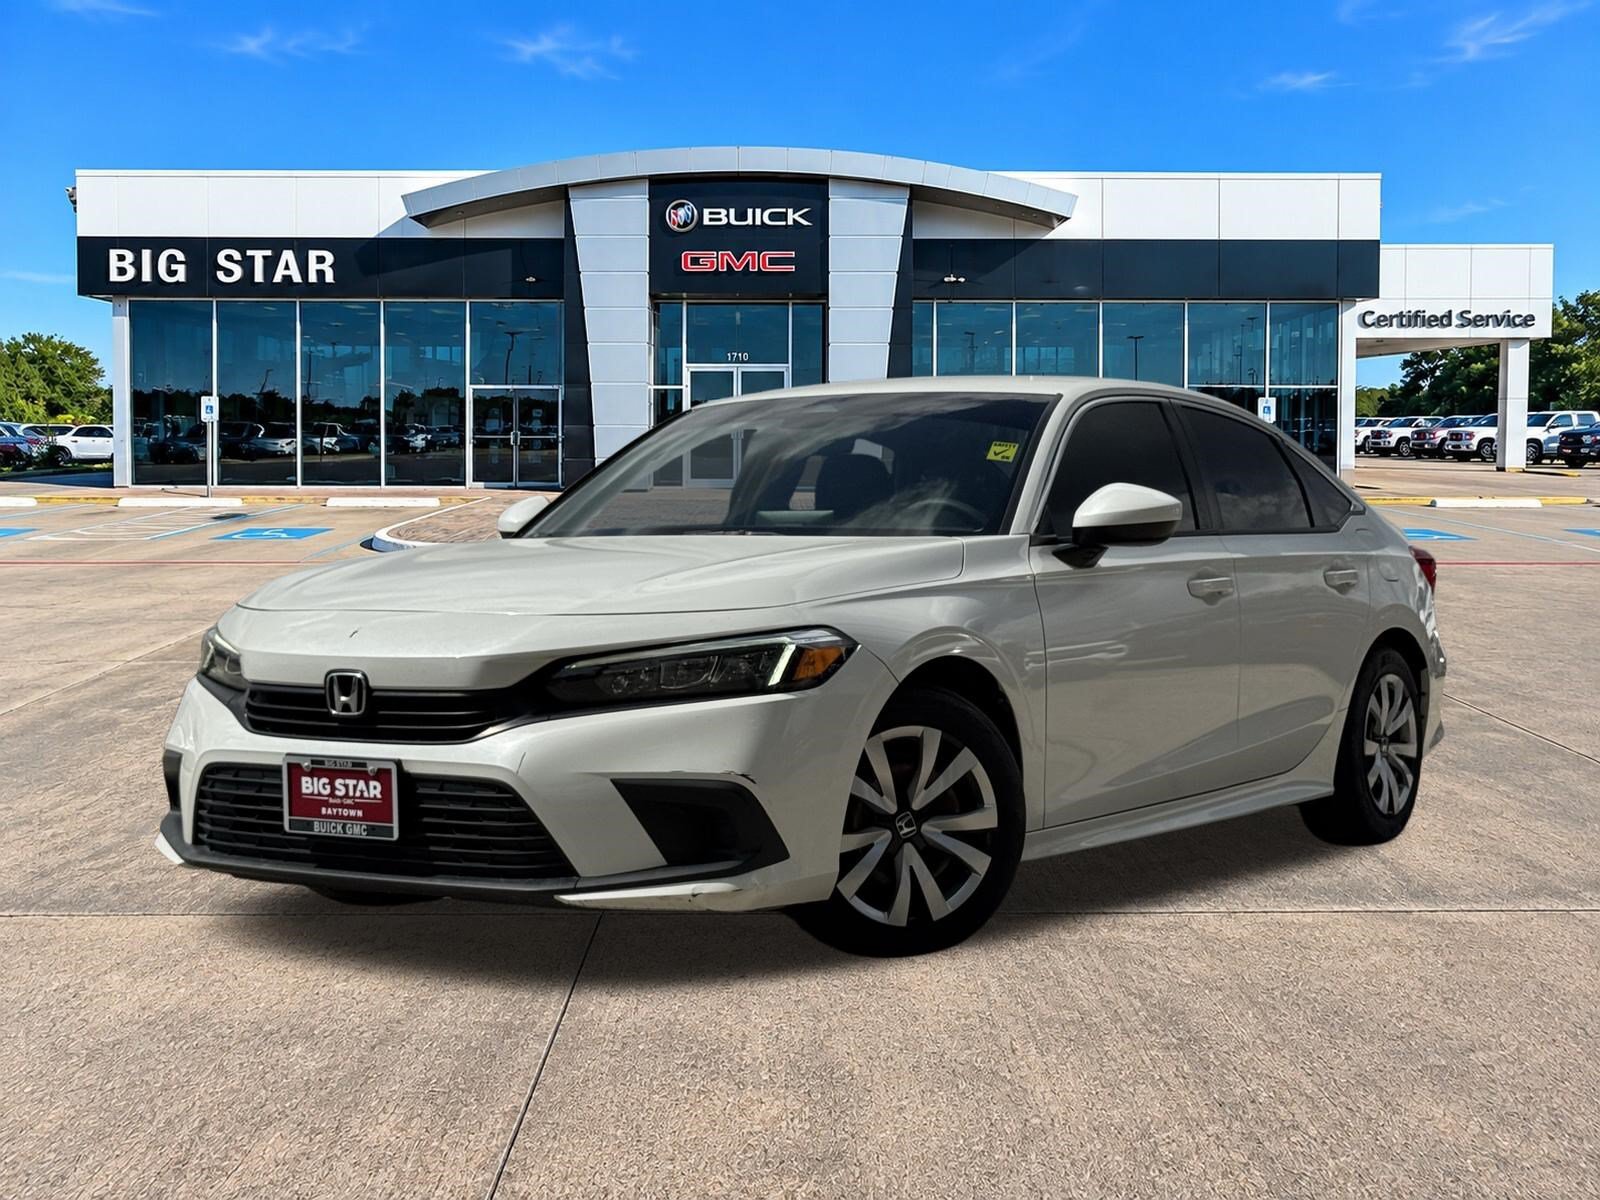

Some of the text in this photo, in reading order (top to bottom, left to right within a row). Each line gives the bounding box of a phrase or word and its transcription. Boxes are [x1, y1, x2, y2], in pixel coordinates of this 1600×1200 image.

[703, 207, 813, 226] BUICK
[108, 248, 336, 284] BIG STAR
[681, 250, 796, 272] GMC
[1360, 309, 1536, 328] Certified Service
[727, 352, 749, 361] 1710
[301, 776, 382, 799] BIG STAR
[321, 807, 363, 818] BAYTOWN
[313, 821, 368, 836] BUICK GMC
